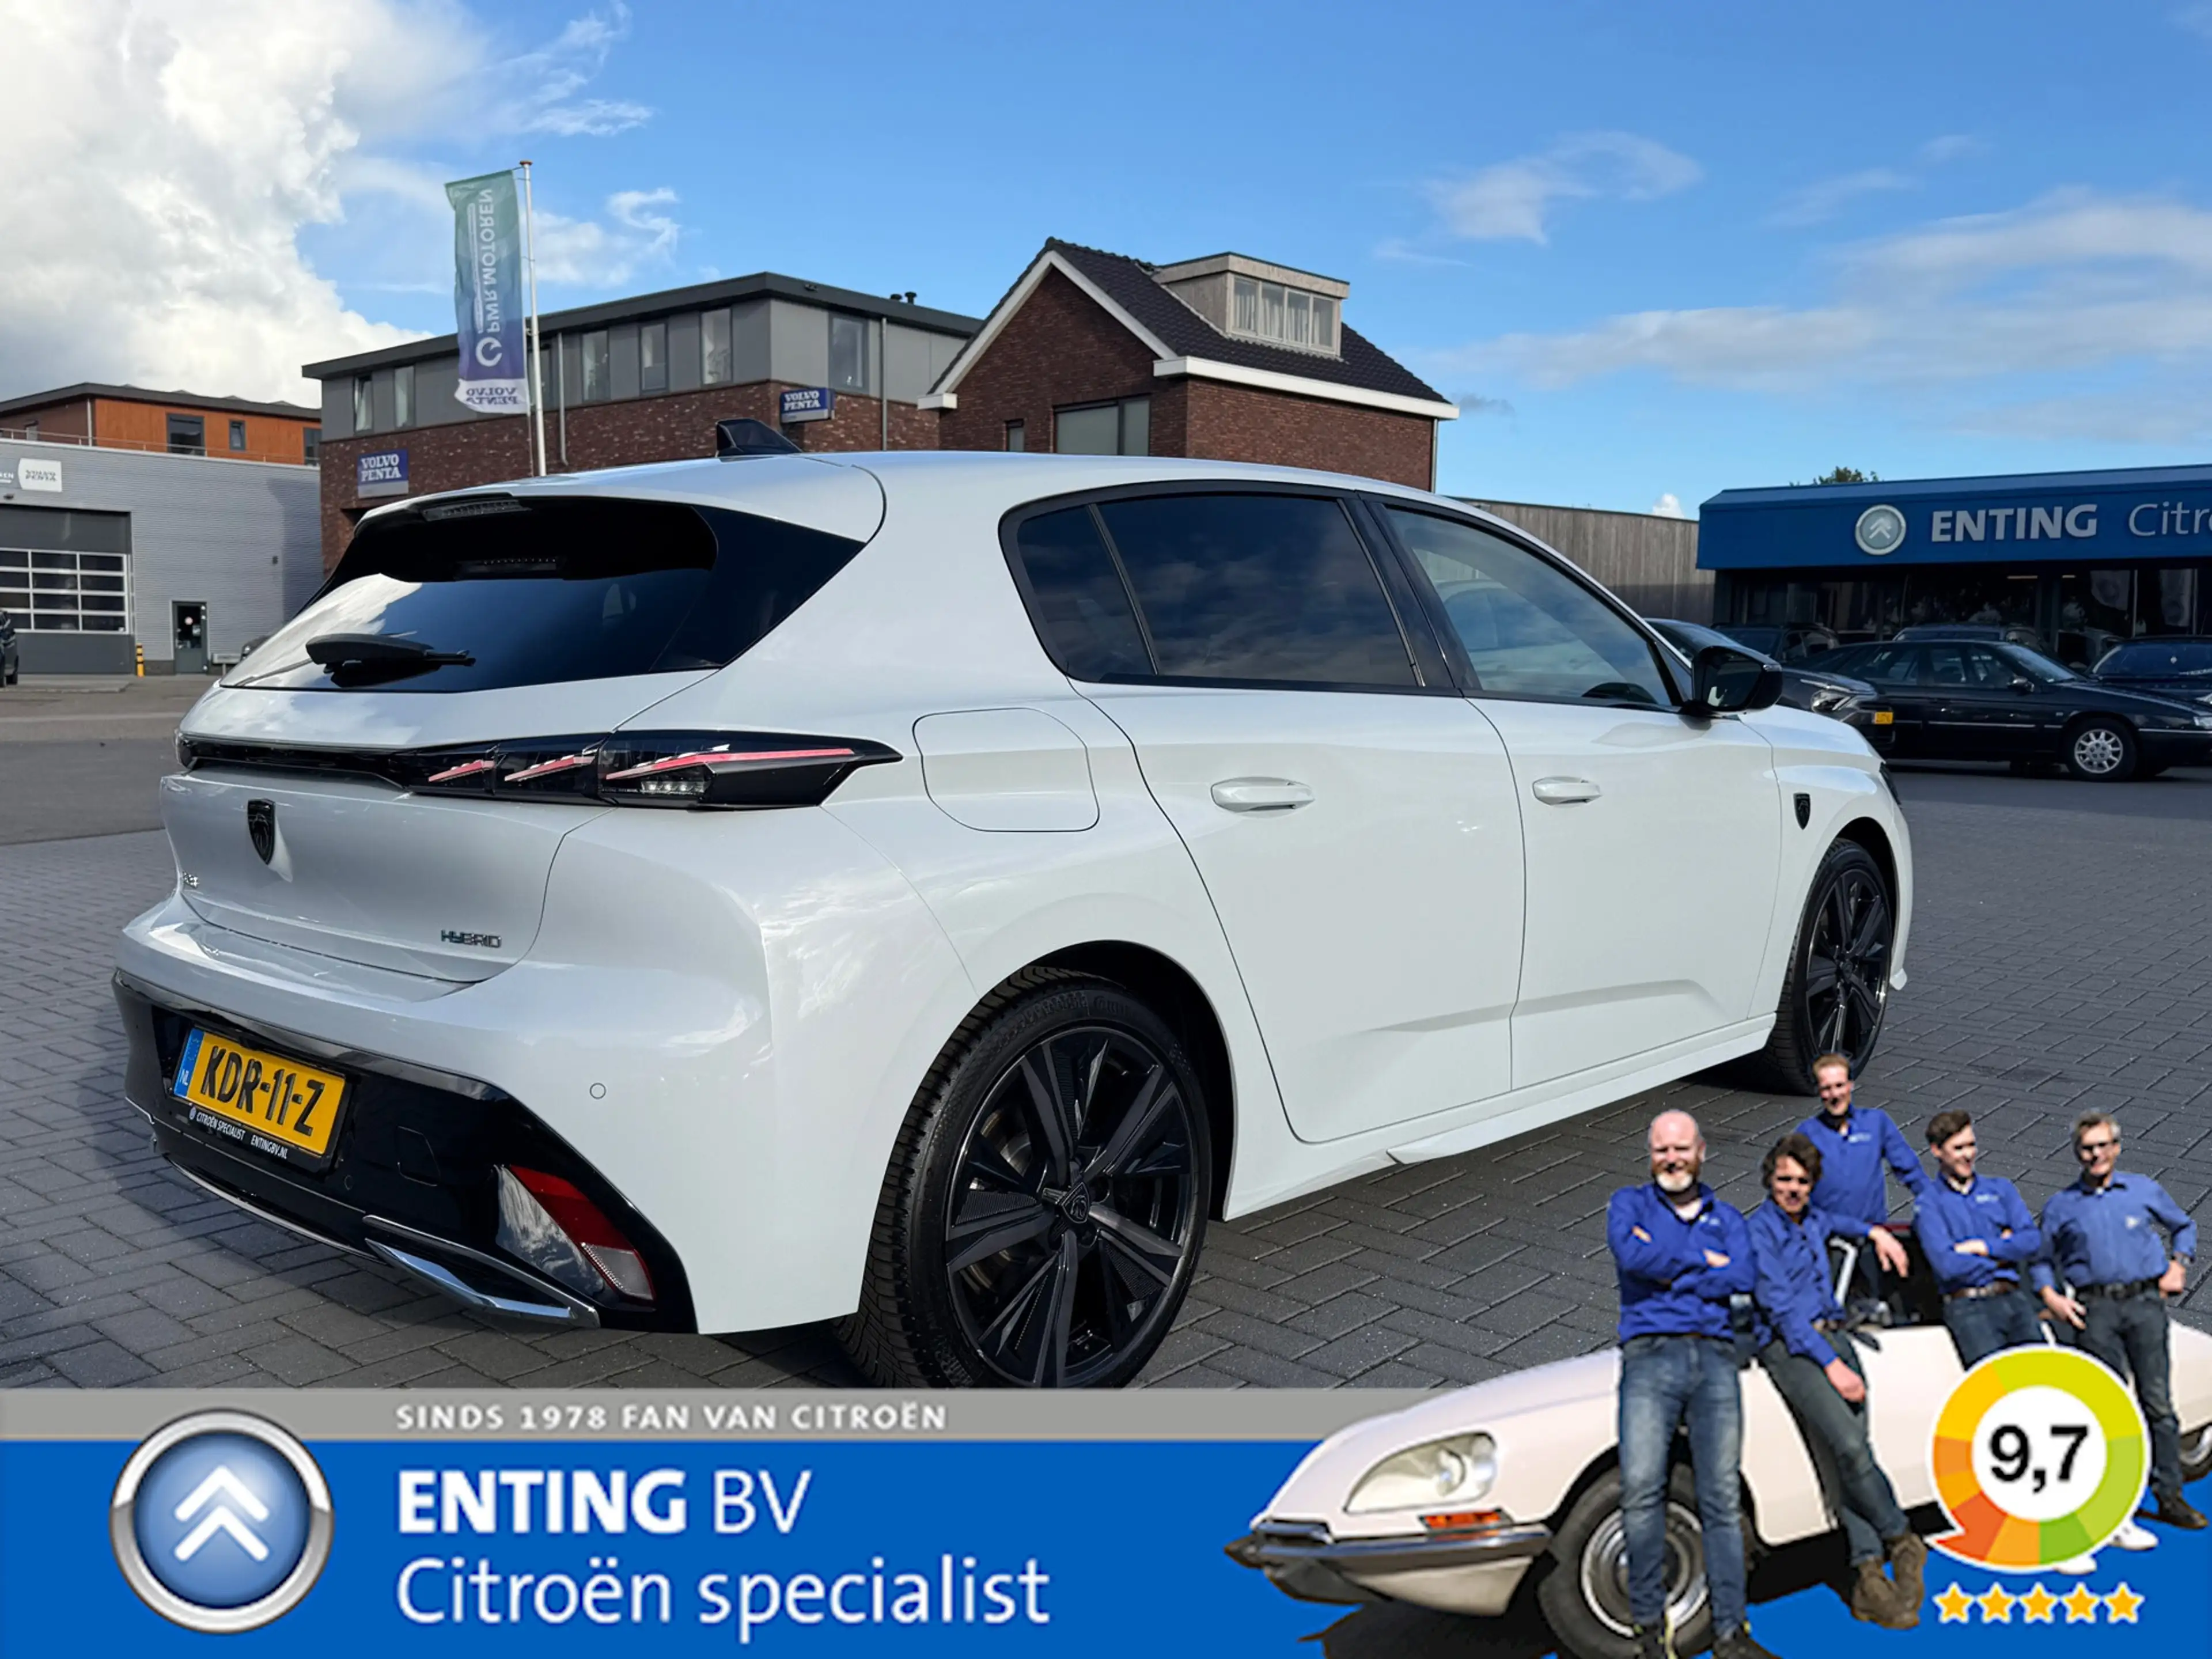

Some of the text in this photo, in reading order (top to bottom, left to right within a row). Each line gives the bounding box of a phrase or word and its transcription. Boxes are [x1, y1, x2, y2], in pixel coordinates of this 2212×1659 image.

[784, 390, 819, 403] VOLVO
[784, 400, 821, 411] PENTA
[361, 454, 400, 469] VOLVO
[361, 467, 402, 482] PENTA
[1931, 501, 2212, 542] ENTING Citr
[441, 929, 502, 948] HYBRID
[179, 1069, 189, 1086] NL
[200, 1045, 325, 1138] KDR-11-Z
[196, 1112, 288, 1160] CITROËN SPECIALIST ENTINGBV.NL
